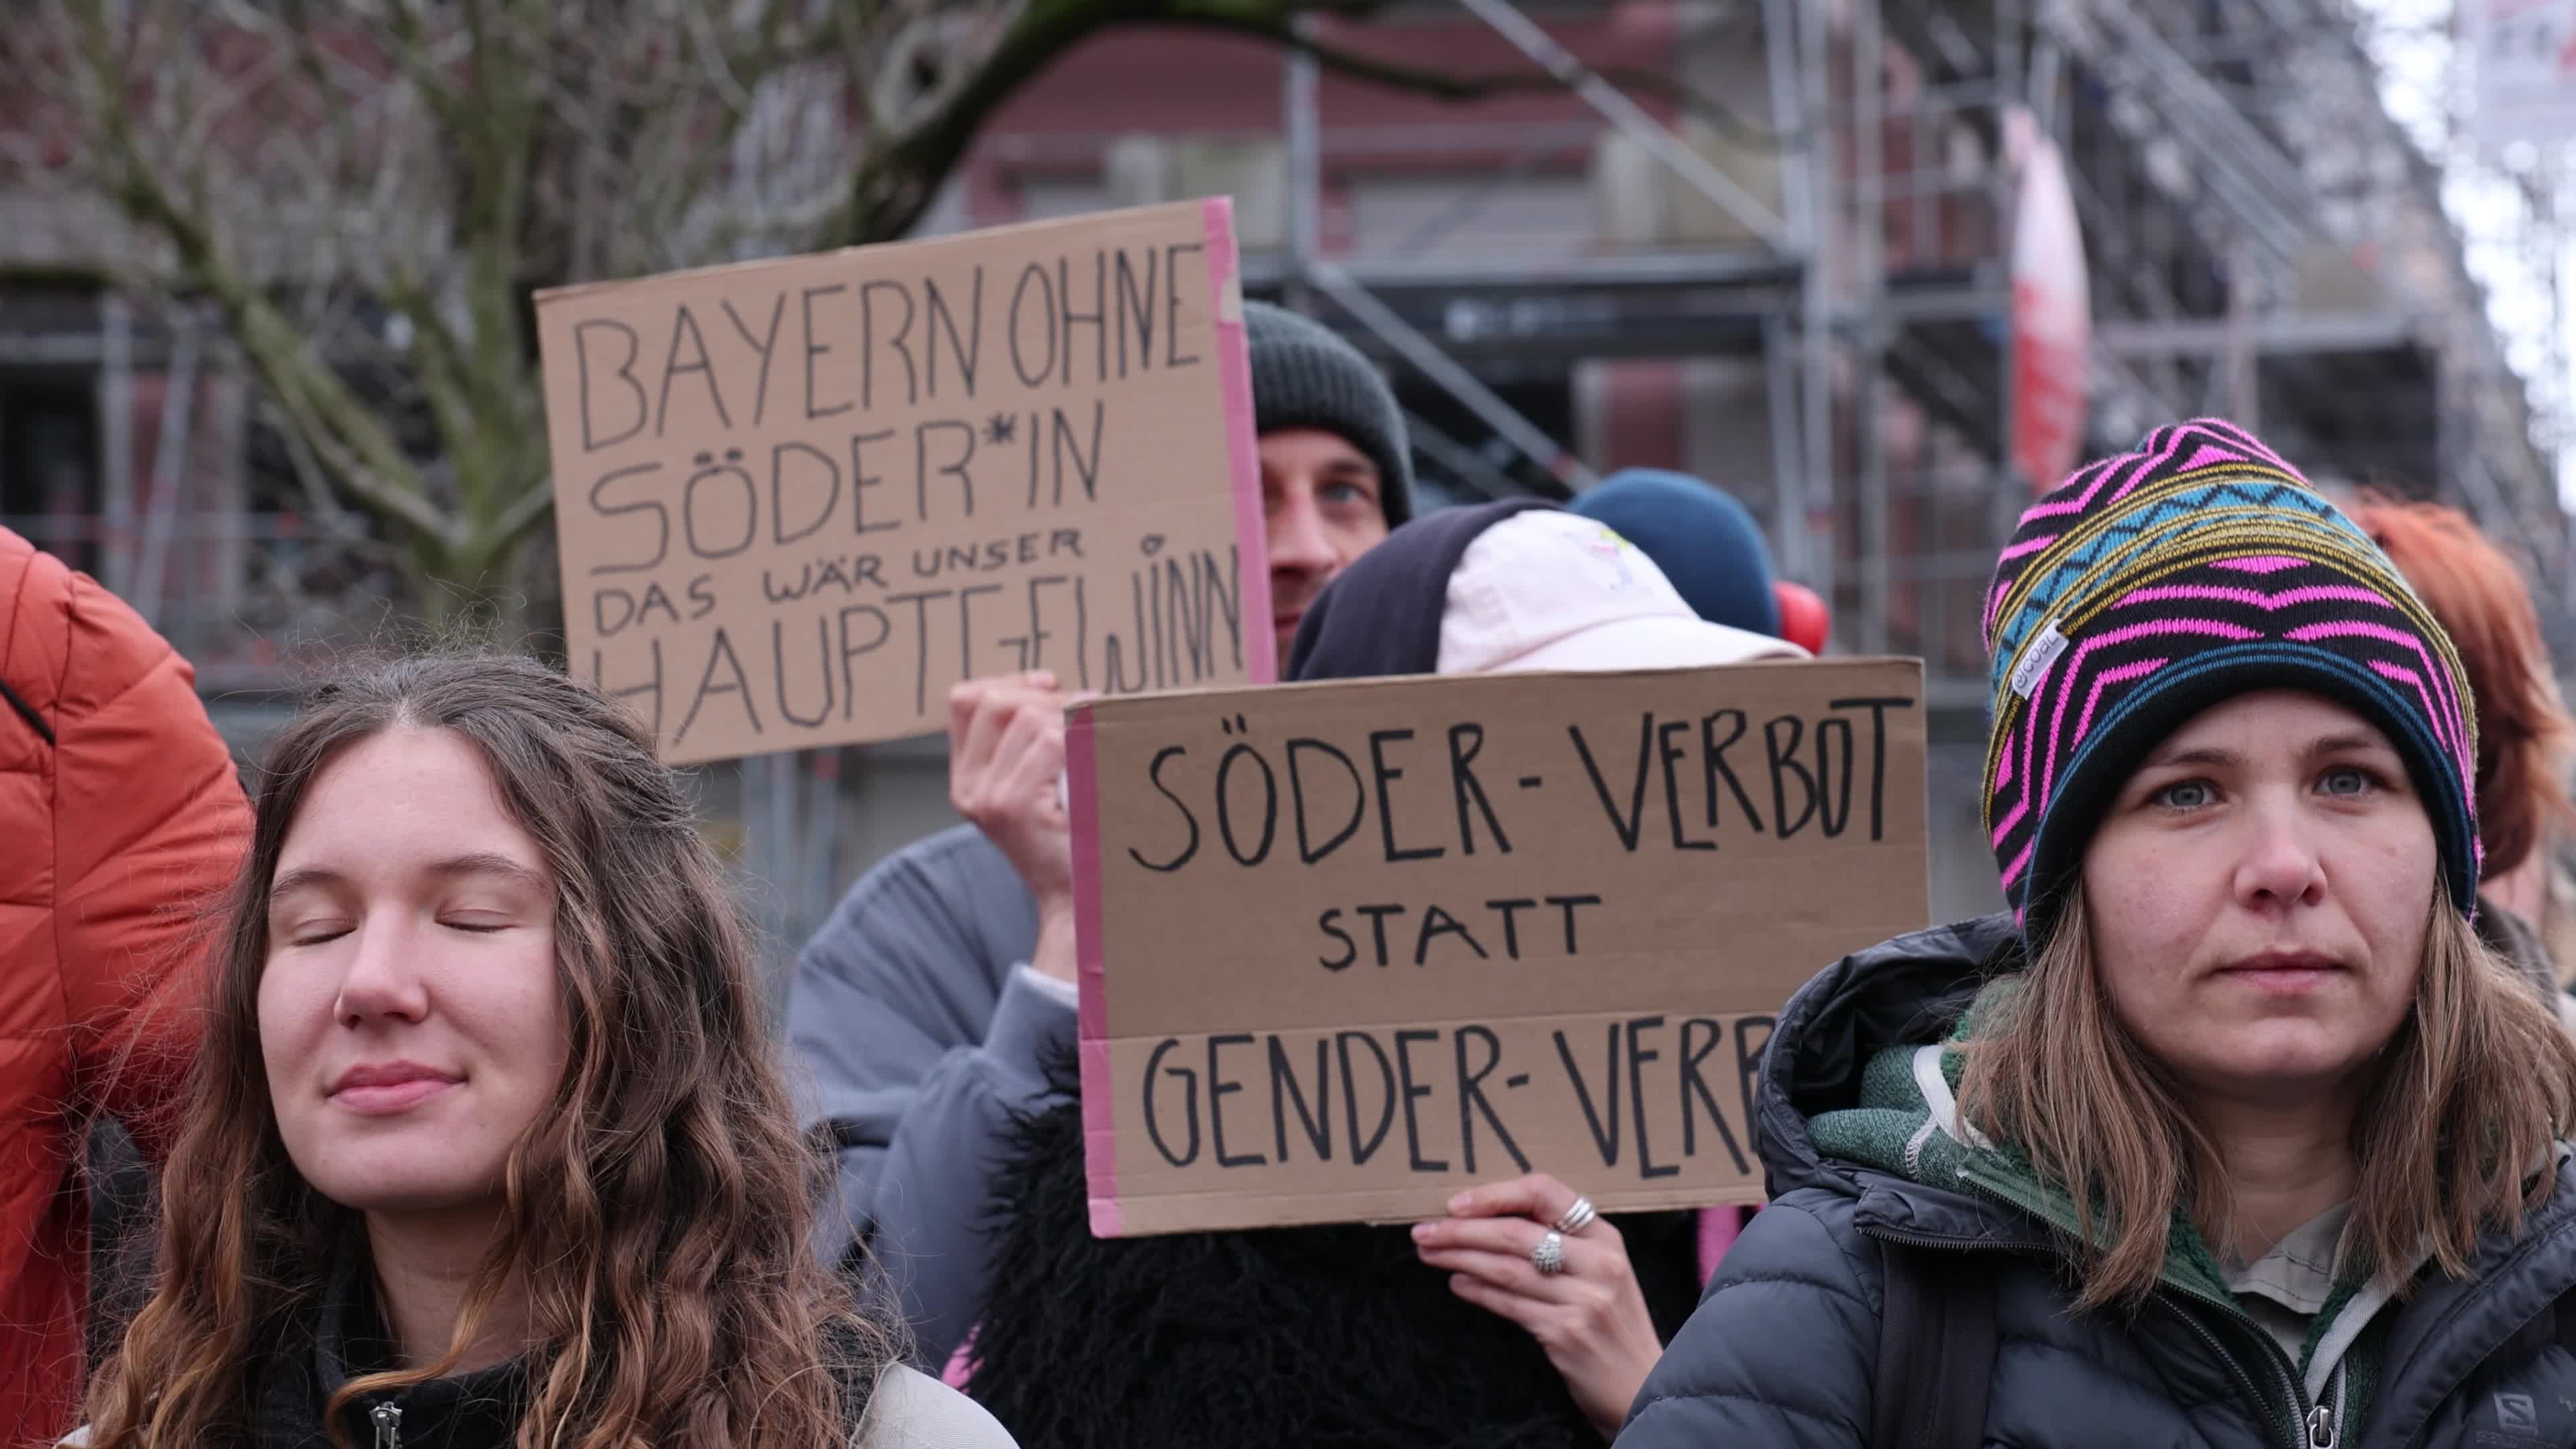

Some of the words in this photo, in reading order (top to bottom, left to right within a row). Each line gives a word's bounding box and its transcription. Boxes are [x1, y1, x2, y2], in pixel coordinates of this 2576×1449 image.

[574, 264, 983, 453] BAYERN
[1008, 243, 1205, 388] OHNE
[594, 575, 718, 637] DAS
[763, 554, 890, 604] WÄR
[912, 528, 1086, 577] UNSER
[1318, 893, 1602, 972] STATT
